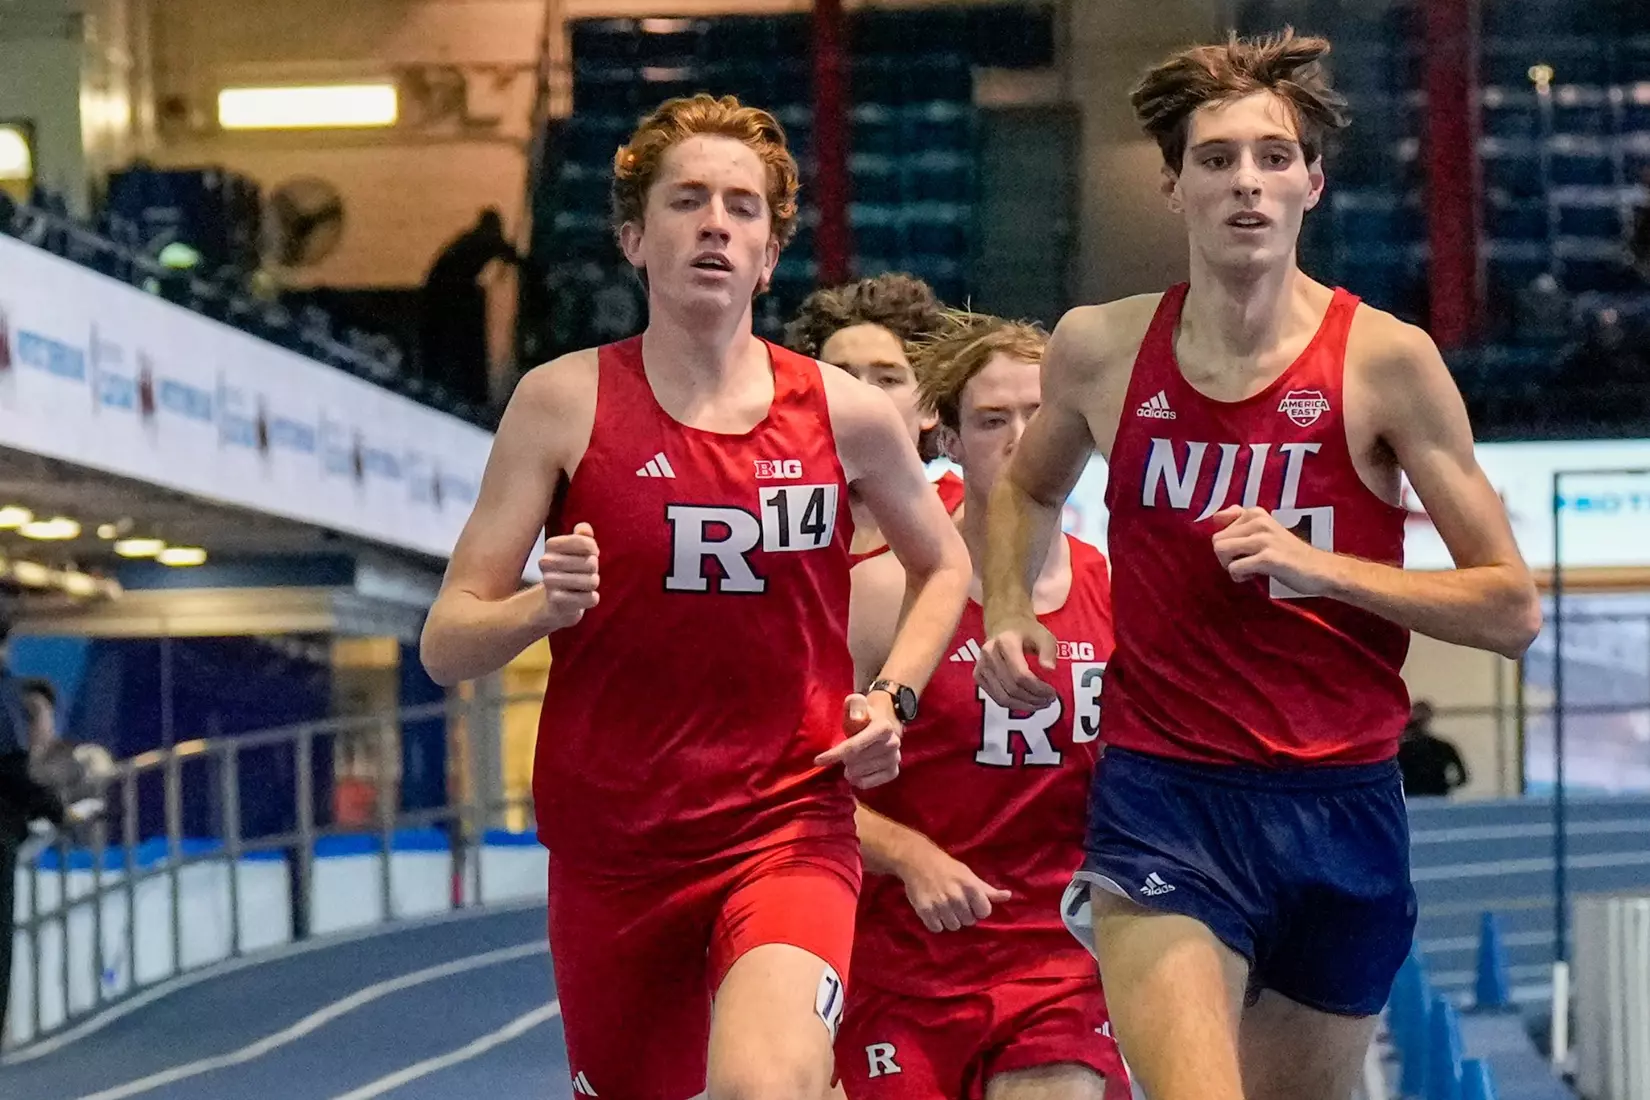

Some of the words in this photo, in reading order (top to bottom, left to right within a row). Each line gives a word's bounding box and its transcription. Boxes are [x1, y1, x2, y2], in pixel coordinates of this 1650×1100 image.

[1136, 407, 1177, 420] adidas
[1280, 400, 1328, 410] AMERICA
[1291, 408, 1317, 416] EAST
[1141, 437, 1322, 523] NJIT
[766, 487, 827, 548] 14
[663, 503, 768, 595] R
[974, 685, 1064, 767] R
[864, 1041, 903, 1080] R
